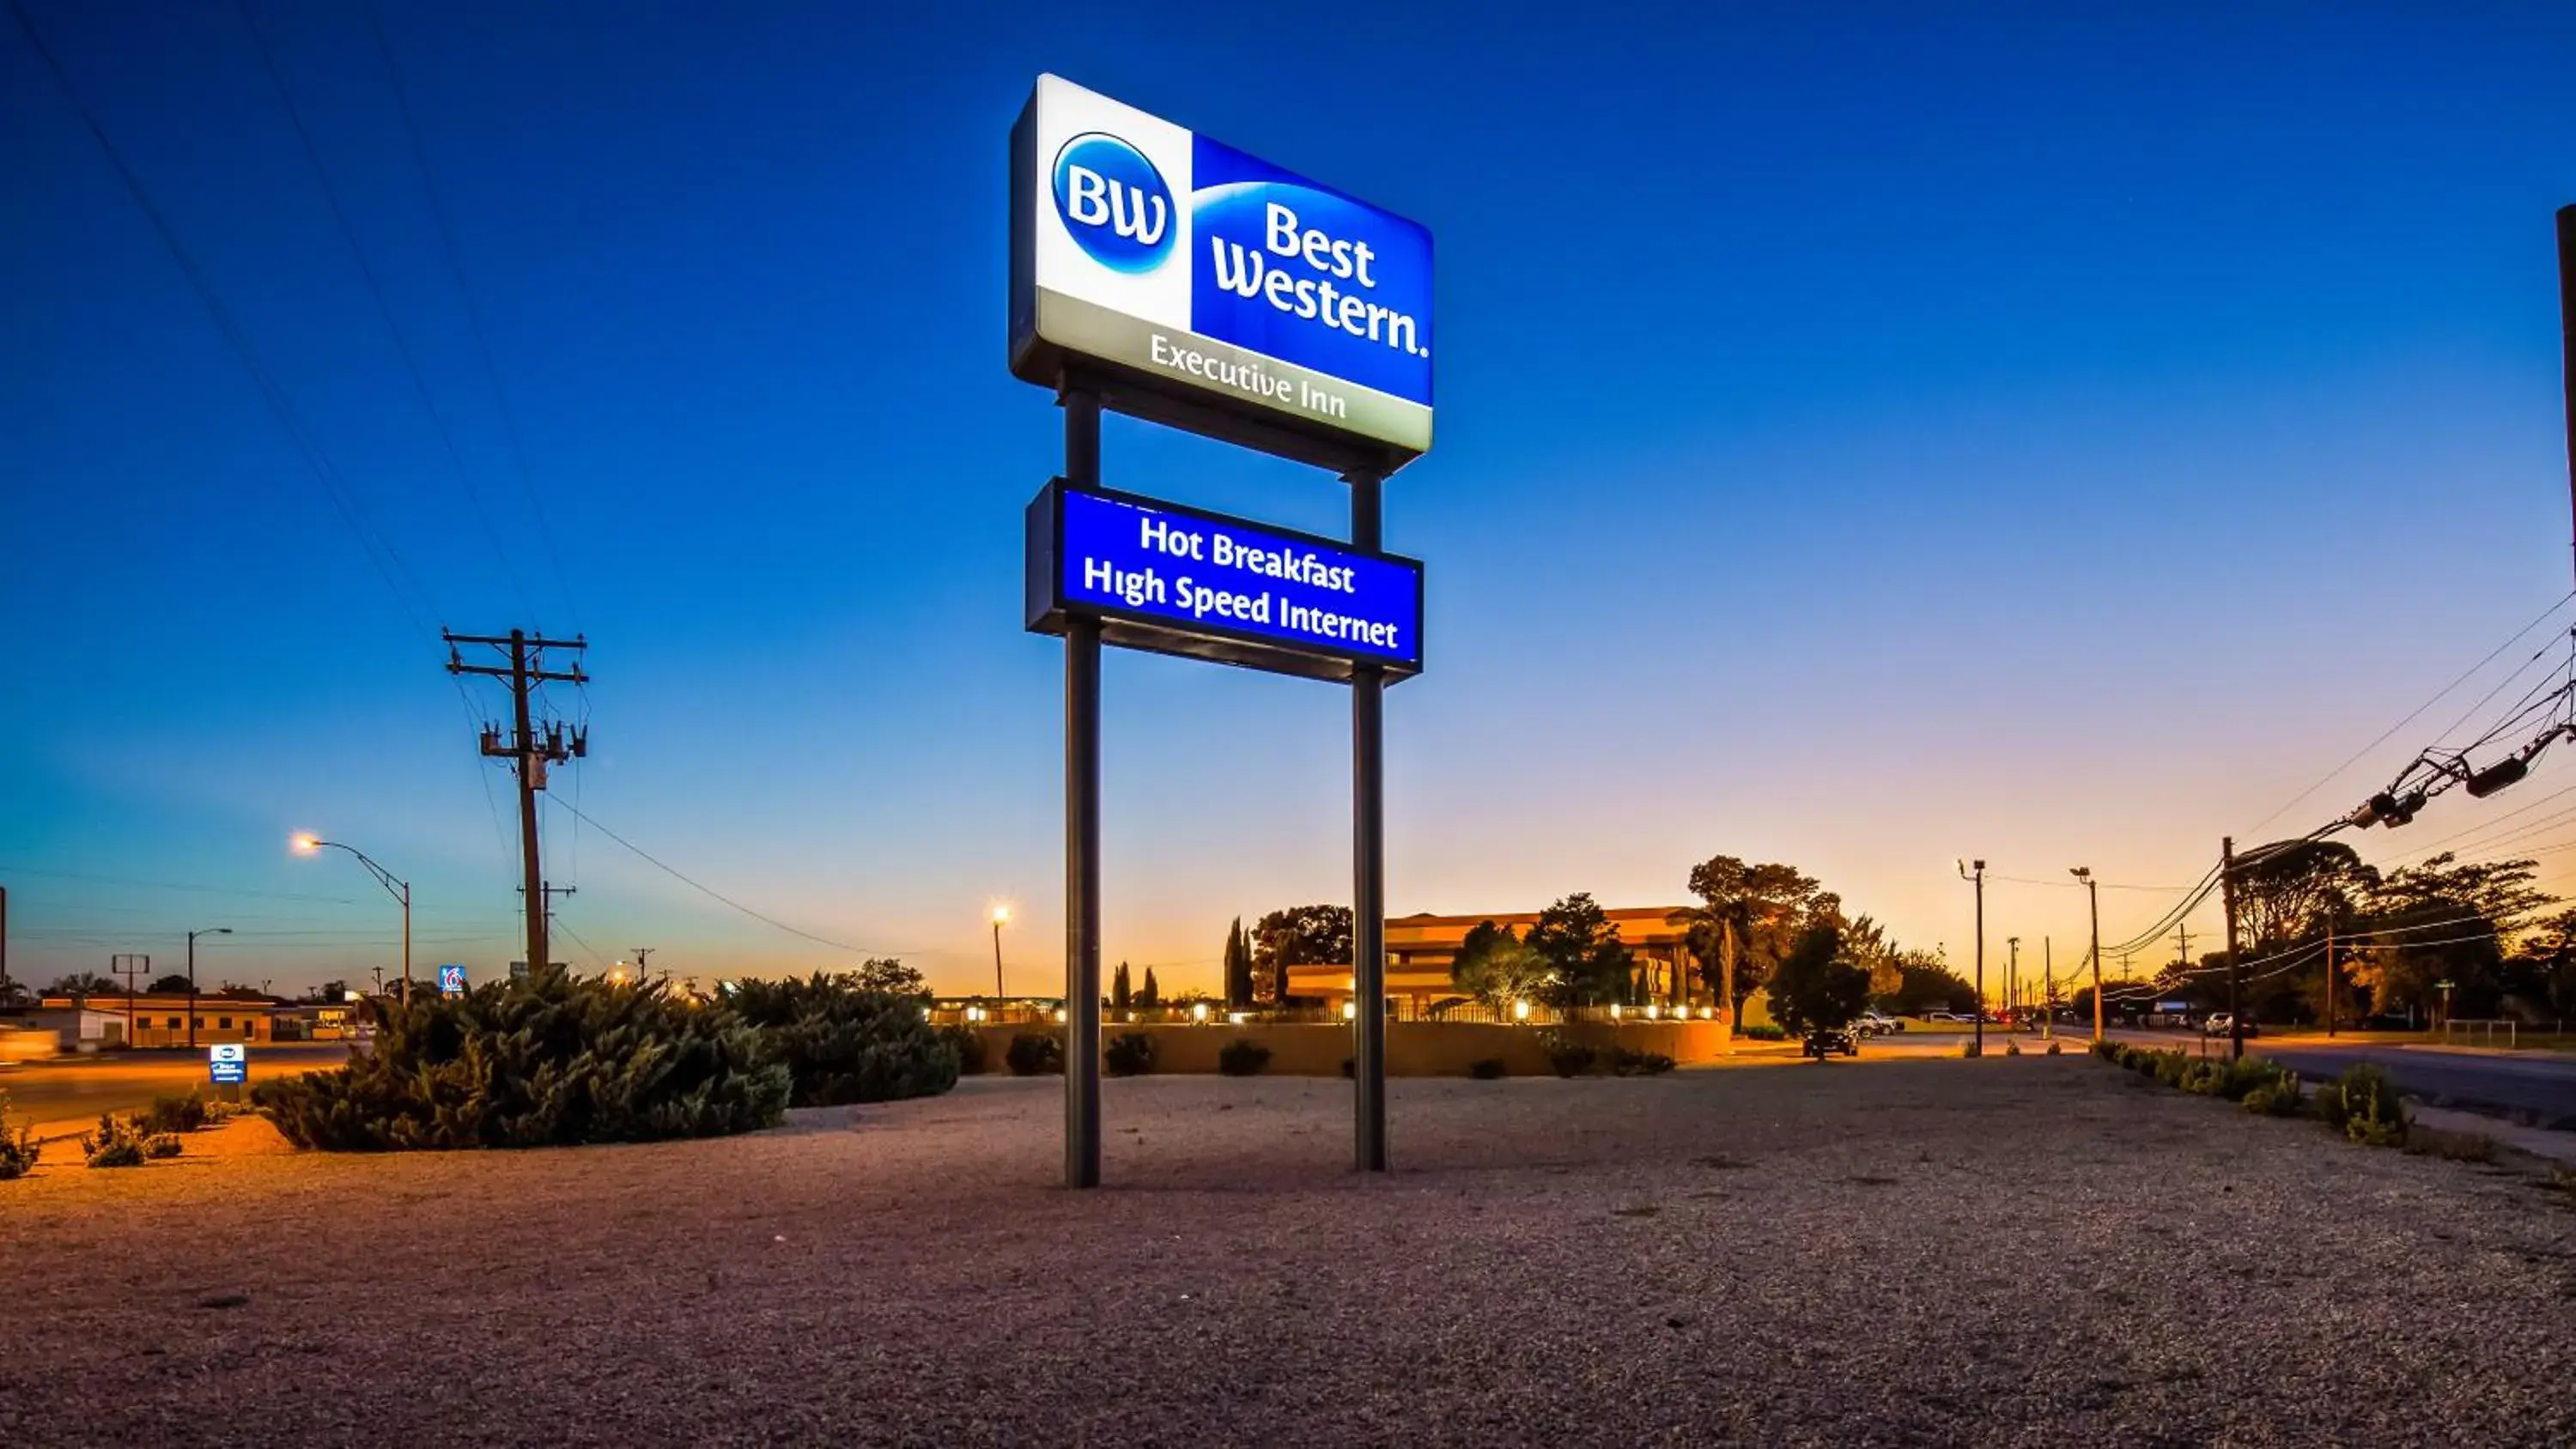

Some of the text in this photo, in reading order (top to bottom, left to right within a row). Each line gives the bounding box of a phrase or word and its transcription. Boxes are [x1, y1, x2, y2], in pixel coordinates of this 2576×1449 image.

[1068, 164, 1166, 246] BW
[1267, 202, 1376, 288] Best
[1151, 334, 1346, 418] Executive Inn
[1141, 517, 1355, 593] Hot Breakfast
[1176, 576, 1270, 619] Speed
[1280, 597, 1398, 648] Internet
